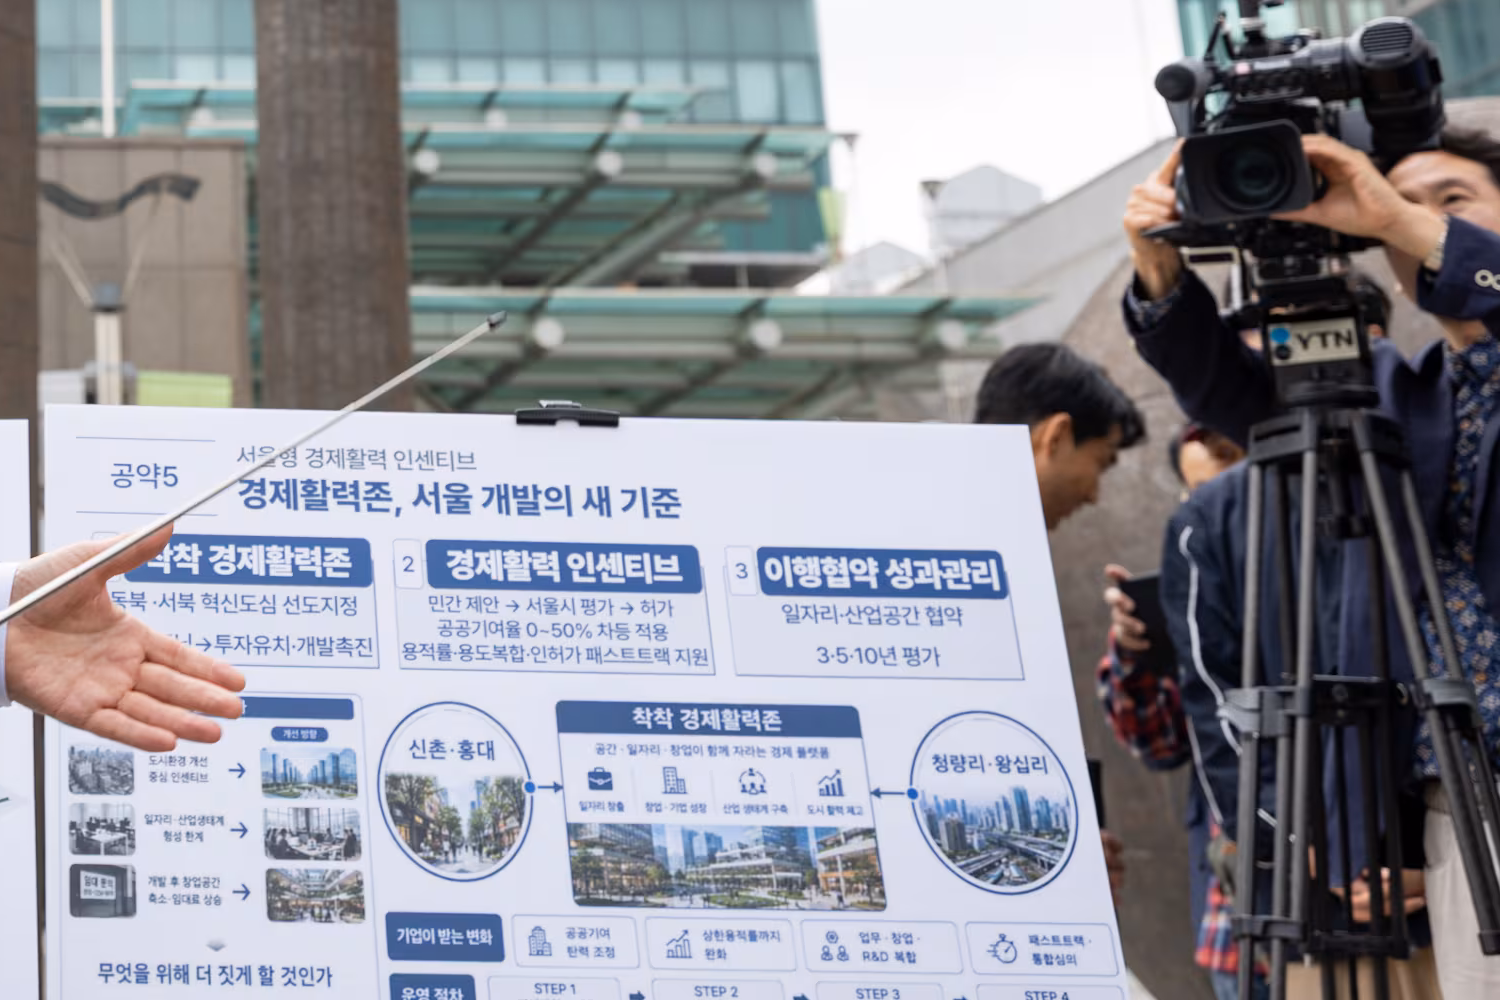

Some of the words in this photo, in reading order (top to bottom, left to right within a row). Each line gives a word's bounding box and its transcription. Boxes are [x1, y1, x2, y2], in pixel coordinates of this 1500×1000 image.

[1296, 328, 1354, 351] YTN
[305, 447, 387, 471] 경제활력
[393, 449, 478, 472] 인센티브
[110, 462, 179, 490] 공약5
[238, 477, 402, 518] 경제활력존,
[411, 481, 473, 515] 서울
[481, 482, 573, 518] 개발의
[582, 485, 612, 518] 새
[621, 486, 682, 519] 기준
[208, 544, 353, 579] 경제활력존
[402, 555, 416, 573] 2
[446, 549, 561, 583] 경제활력
[566, 551, 684, 585] 인센티브
[735, 562, 749, 580] 3
[764, 555, 880, 590] 이행협약
[885, 558, 1001, 592] 성과관리
[201, 592, 277, 615] 혁신도심
[282, 595, 358, 617] 선도지정
[428, 595, 462, 614] 민간
[465, 596, 500, 615] 제안
[526, 597, 577, 617] 서울시
[580, 598, 615, 617] 평가
[640, 598, 675, 618] 허가
[924, 606, 964, 628] 협약
[437, 618, 522, 639] 공공기여율
[597, 622, 632, 640] 차등
[635, 623, 669, 642] 적용
[213, 634, 373, 658] 투자유치·개발촉진
[585, 646, 671, 666] 패스트트랙
[675, 648, 709, 667] 지원
[902, 647, 941, 668] 평가
[632, 707, 674, 730] 착착
[679, 709, 783, 732] 경제활력존
[595, 743, 617, 756] 공간
[627, 744, 661, 756] 일자리
[733, 746, 767, 758] 자라는
[148, 755, 187, 767] 도시환경
[189, 756, 209, 768] 개선
[148, 771, 168, 783] 중심
[171, 772, 209, 784] 인센티브
[182, 876, 221, 889] 창업공간
[397, 928, 437, 945] 기업이
[438, 929, 465, 946] 받는
[466, 929, 493, 946] 변화
[565, 927, 612, 940] 공공기여
[862, 951, 889, 962] R&D
[98, 963, 150, 985] 무엇을
[156, 964, 190, 985] 위해
[196, 965, 213, 986] 더
[218, 965, 253, 986] 짓게
[257, 966, 275, 987] 할
[280, 966, 333, 988] 것인가
[534, 982, 567, 995] STEP
[570, 984, 577, 995] 1
[694, 986, 727, 997] STEP
[730, 986, 739, 998] 2
[856, 988, 889, 1000] STEP
[891, 988, 901, 1000] 3
[1024, 990, 1058, 1000] STEP
